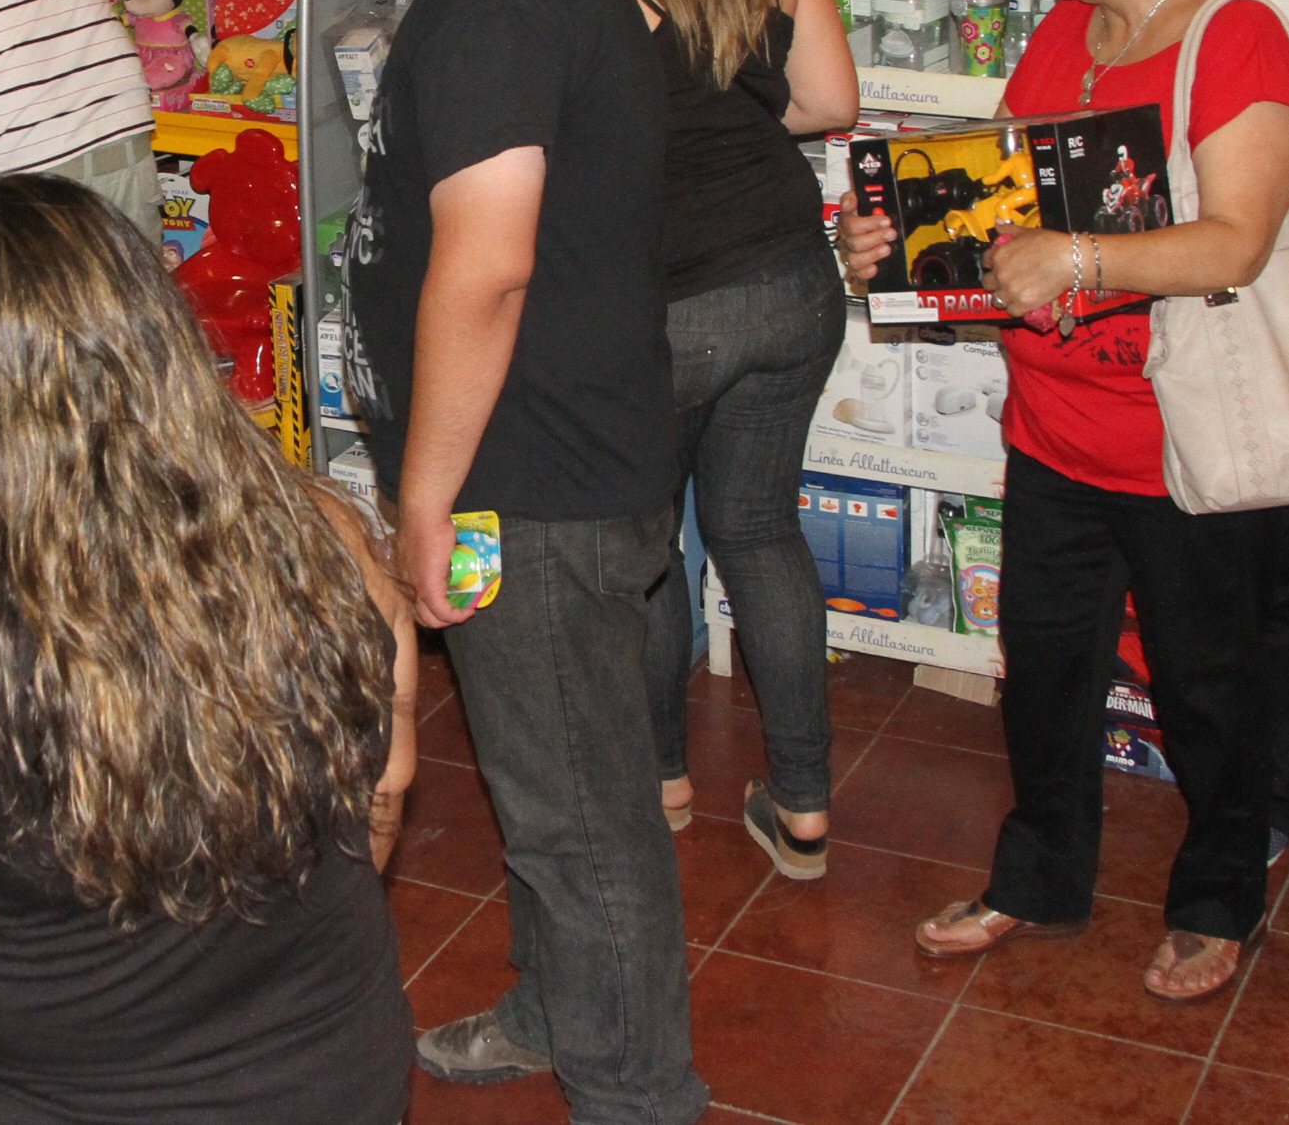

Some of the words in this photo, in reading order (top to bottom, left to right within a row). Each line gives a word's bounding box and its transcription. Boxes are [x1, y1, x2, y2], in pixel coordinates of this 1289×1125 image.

[859, 81, 940, 105] llattasicura
[164, 196, 196, 219] OY
[944, 293, 996, 314] RACI
[332, 467, 358, 479] PHILIPS
[849, 451, 938, 482] Allattasicura
[827, 626, 846, 642] nea
[849, 626, 936, 658] Allattasicura
[1105, 754, 1135, 766] mimo
